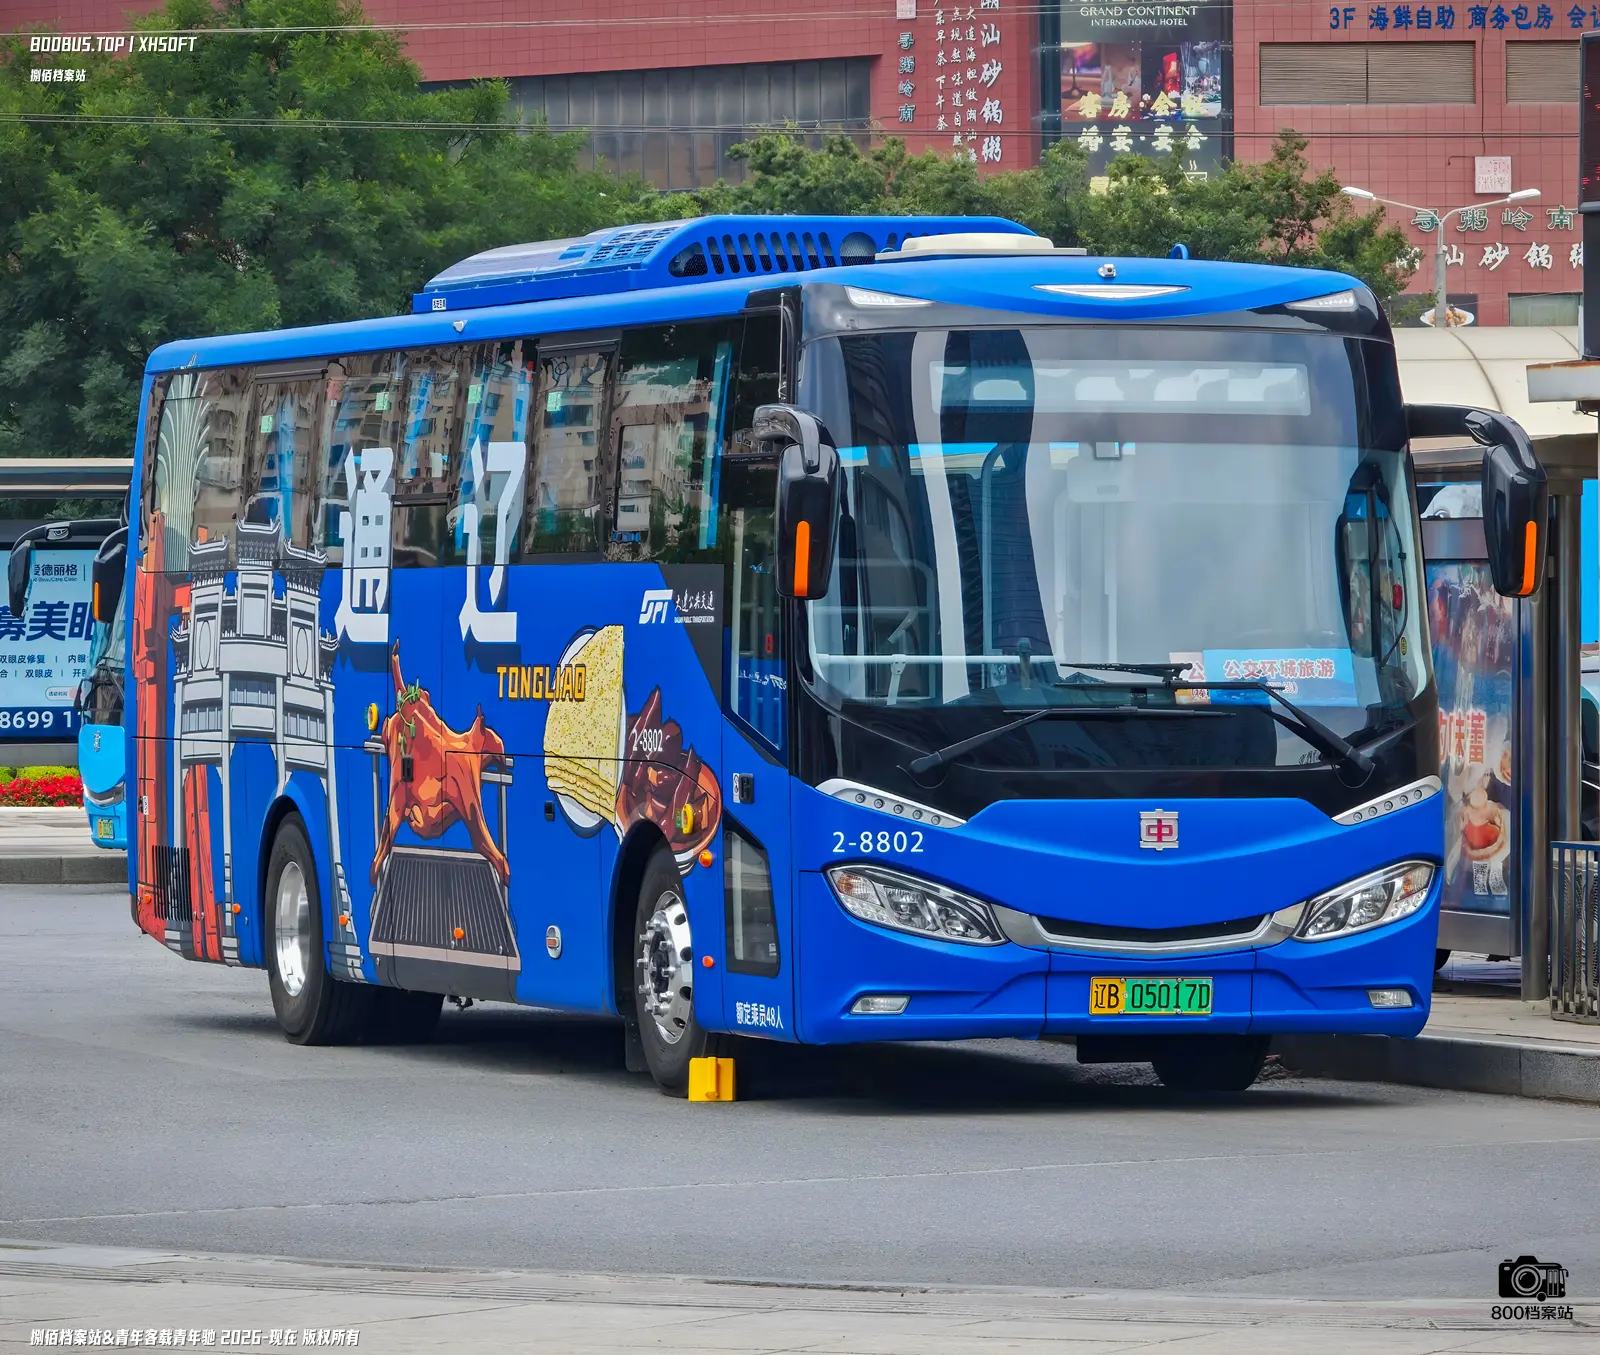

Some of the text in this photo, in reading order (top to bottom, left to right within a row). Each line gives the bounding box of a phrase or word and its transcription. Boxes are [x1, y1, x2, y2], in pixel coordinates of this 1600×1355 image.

[1080, 5, 1199, 16] GRAND CONTINENT
[1330, 7, 1356, 29] 3F
[1369, 5, 1455, 31] 海鲜自助
[1468, 5, 1554, 30] 商务包房
[1091, 18, 1188, 26] INTERNATIONAL HOTEL
[934, 0, 949, 131] 东早茶下午茶
[68, 654, 89, 664] 内眼
[1223, 658, 1335, 680] 公交环城旅游
[25, 669, 53, 678] 双眼皮
[496, 663, 587, 703] TONGLIAO
[63, 710, 81, 728] 1
[632, 728, 663, 752] 2-8802
[832, 831, 924, 852] 2-8802
[1094, 983, 1211, 1009] 辽B 05017D
